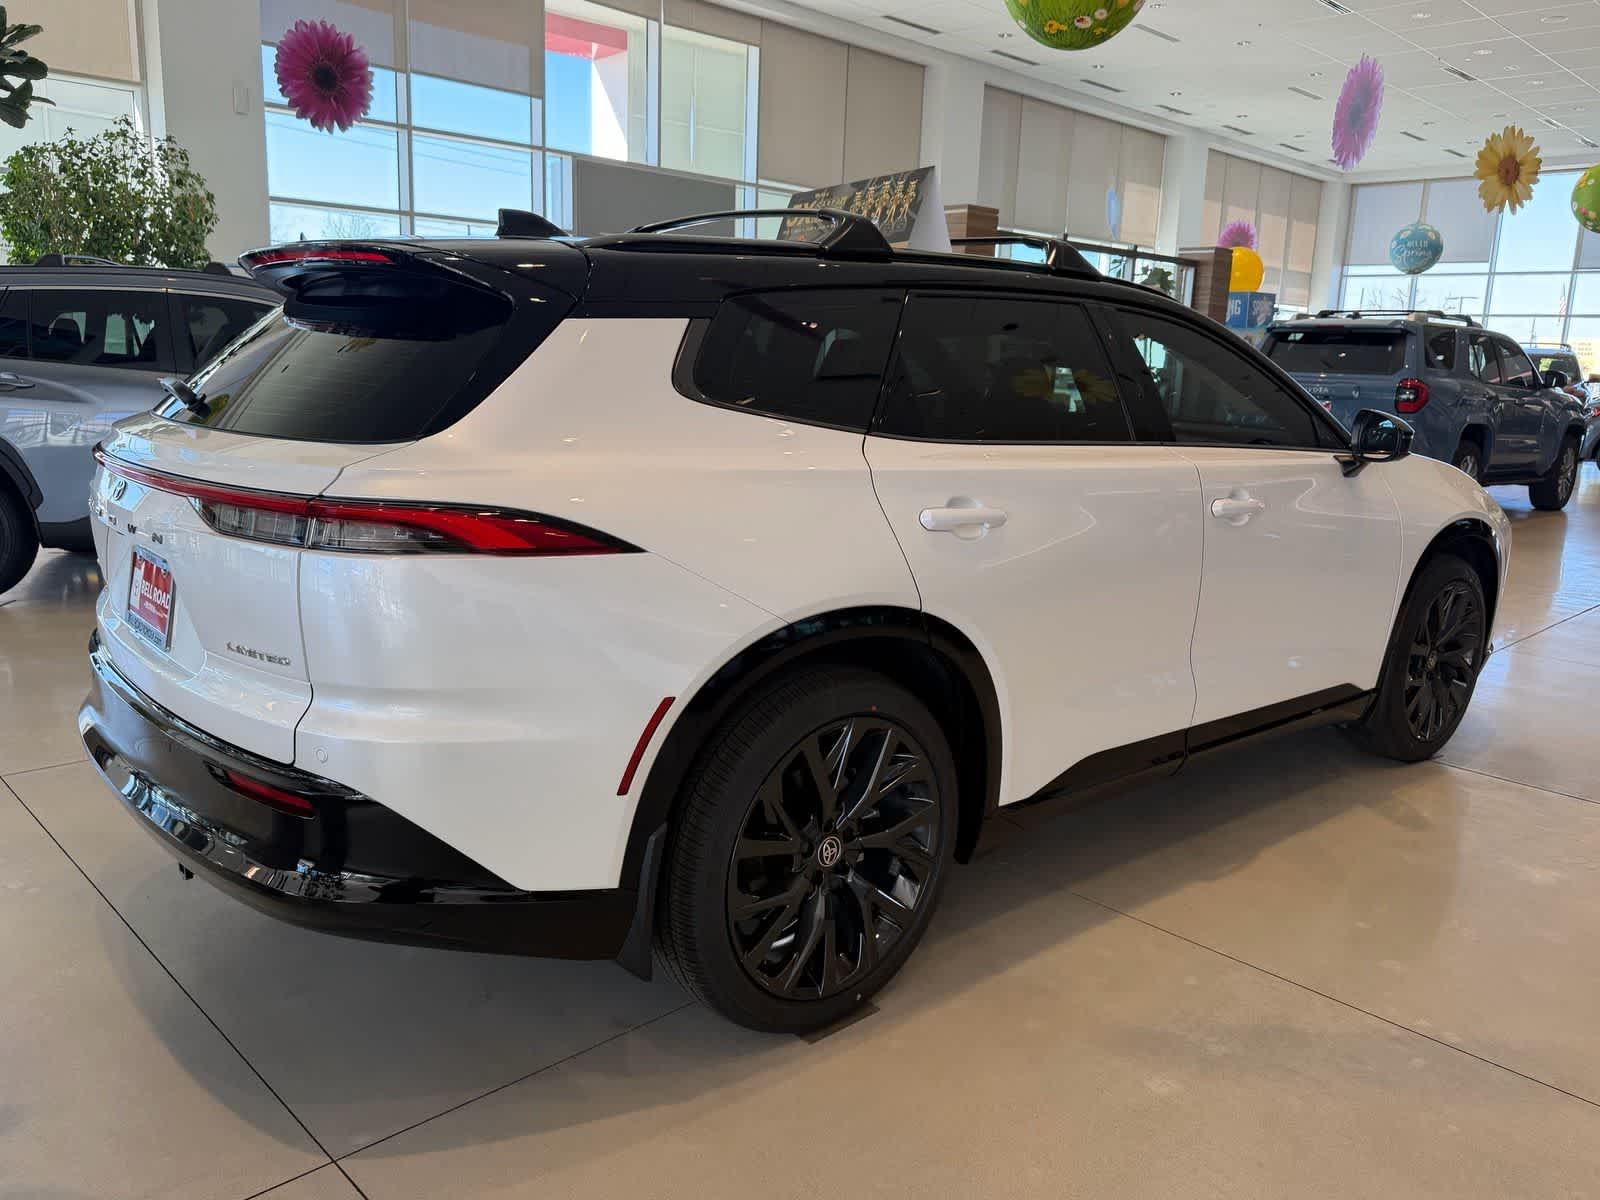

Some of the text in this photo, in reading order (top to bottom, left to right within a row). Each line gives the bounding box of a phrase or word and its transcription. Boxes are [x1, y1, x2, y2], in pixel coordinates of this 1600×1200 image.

[141, 580, 154, 601] BELL
[153, 588, 171, 609] ROAD
[226, 641, 291, 666] LIMITED
